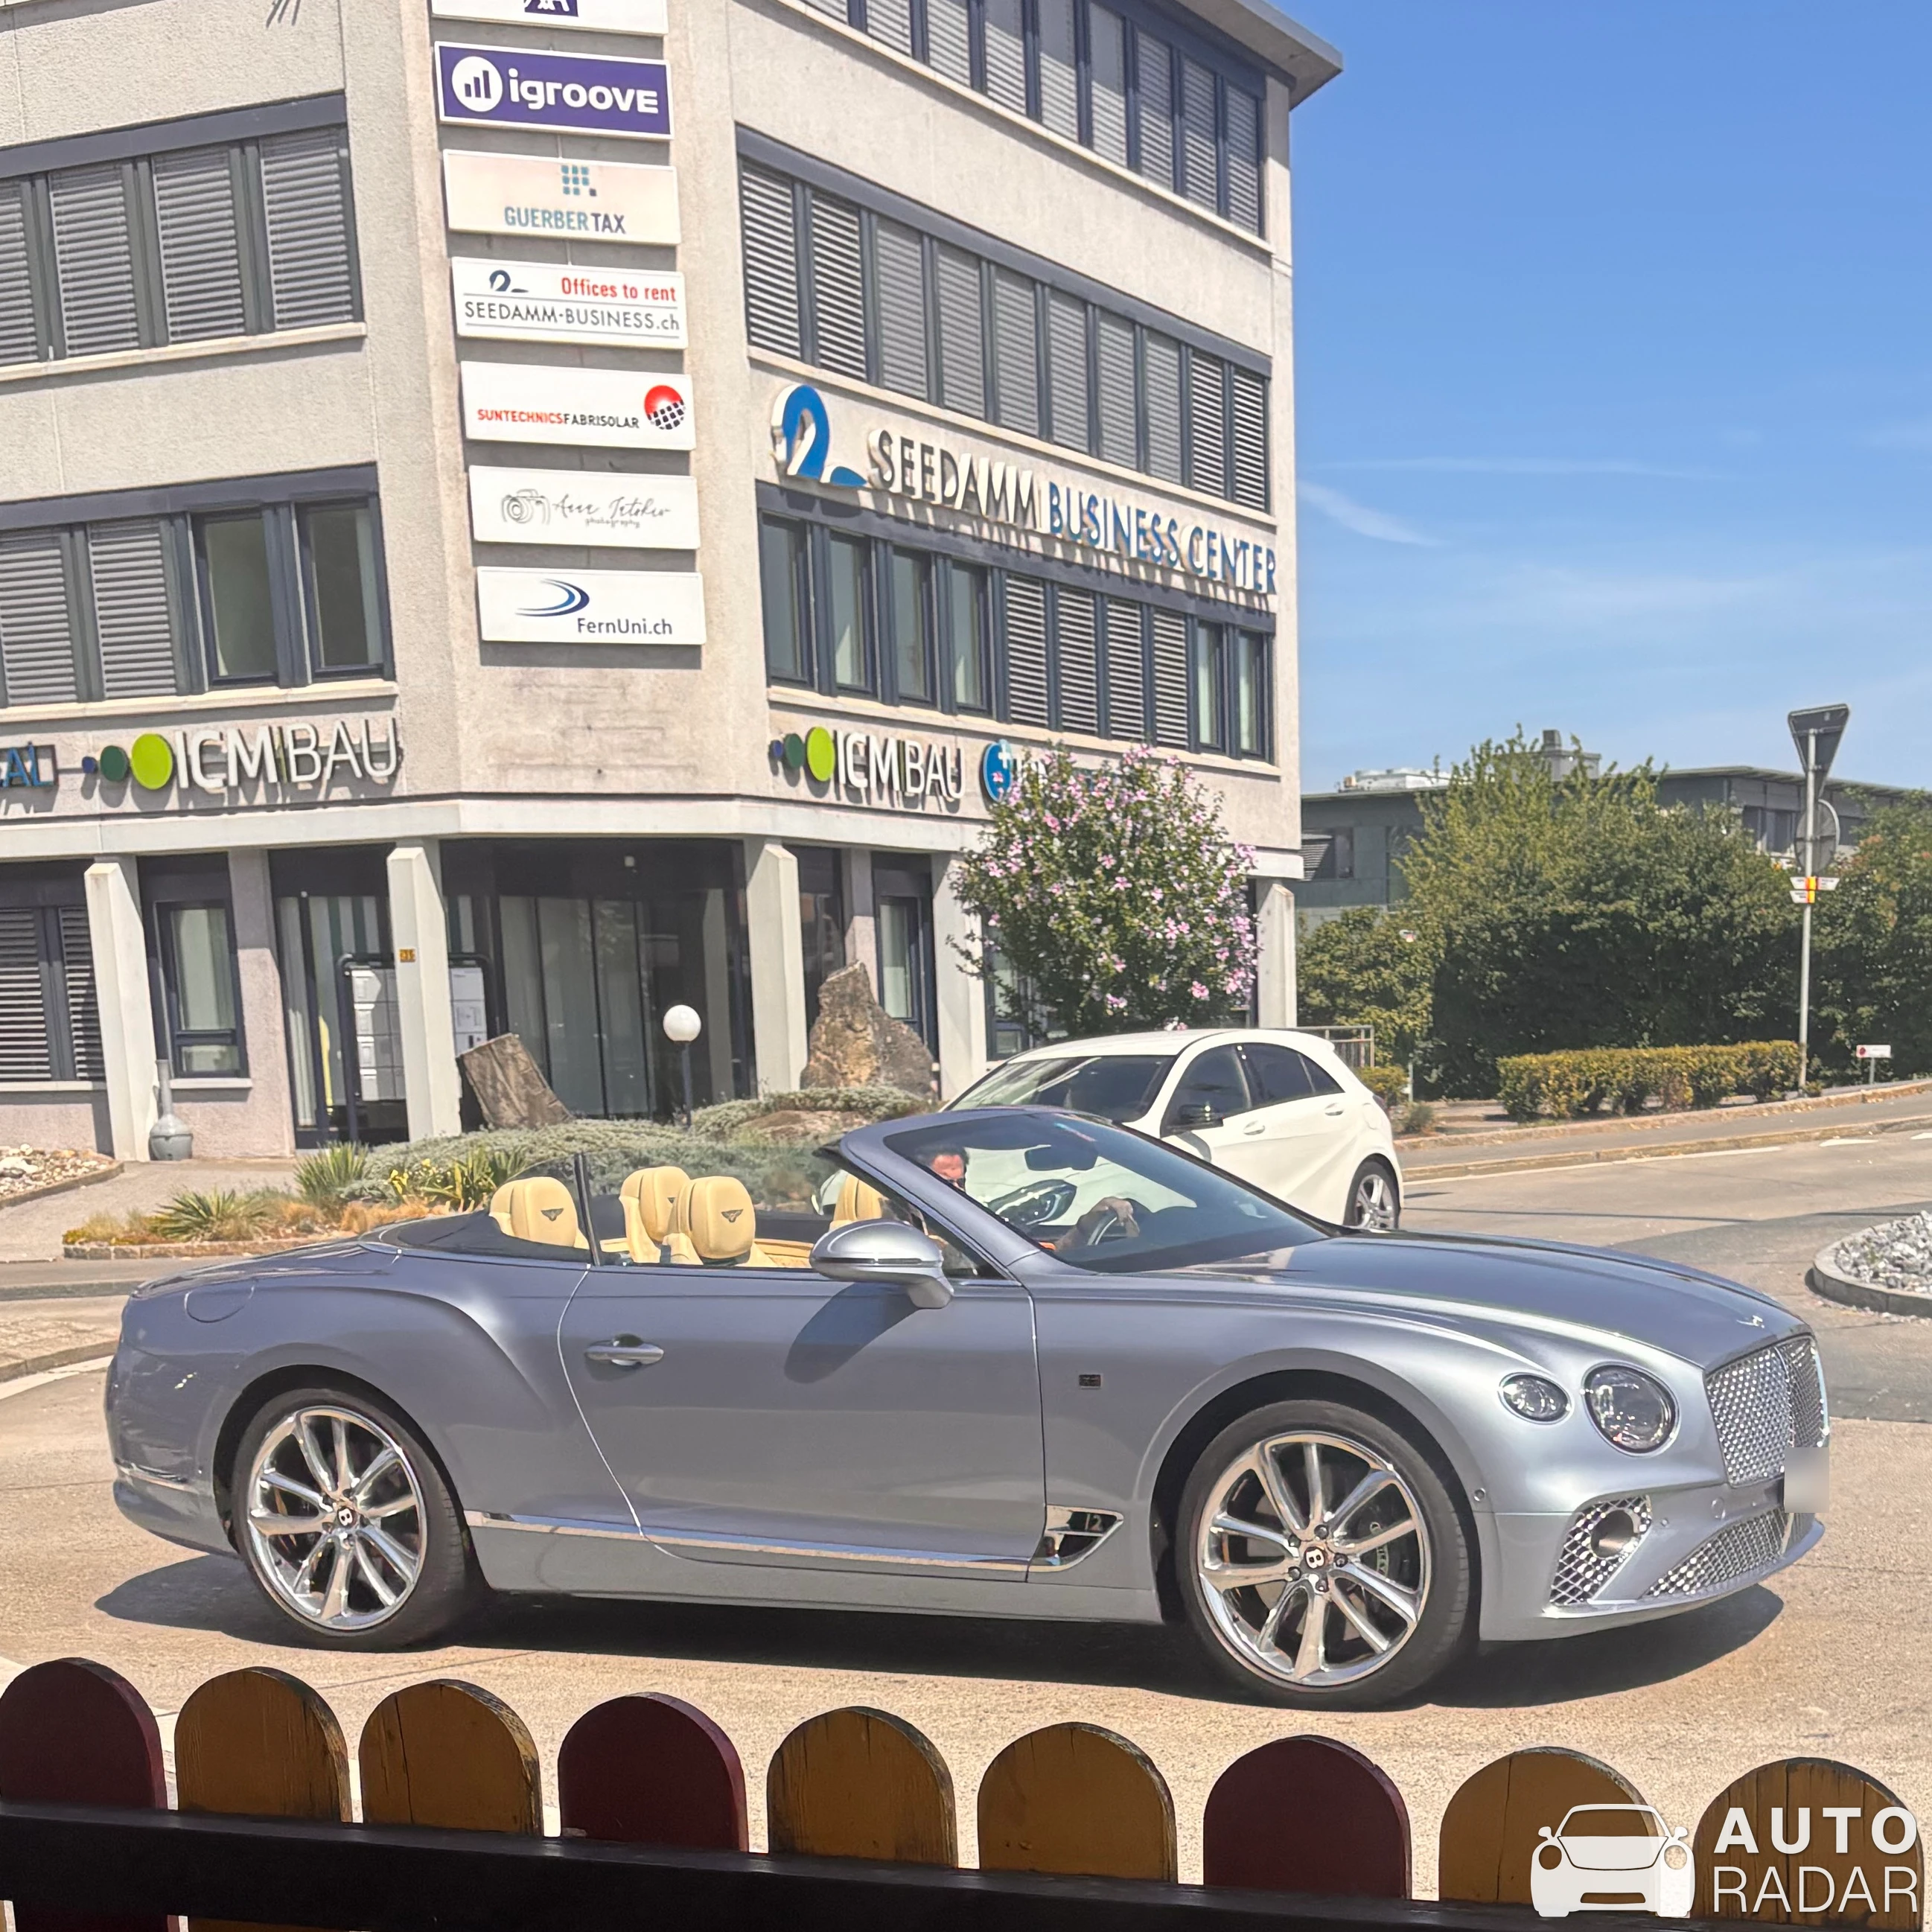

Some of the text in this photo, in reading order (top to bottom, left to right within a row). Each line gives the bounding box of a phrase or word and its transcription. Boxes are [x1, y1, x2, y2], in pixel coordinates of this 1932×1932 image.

[591, 212, 626, 235] TAX
[561, 277, 677, 302] Offices to rent
[869, 429, 1278, 595] SEEDAMM BUSINESS CENTER
[577, 618, 673, 635] FernUni.ch
[0, 746, 55, 788] AL
